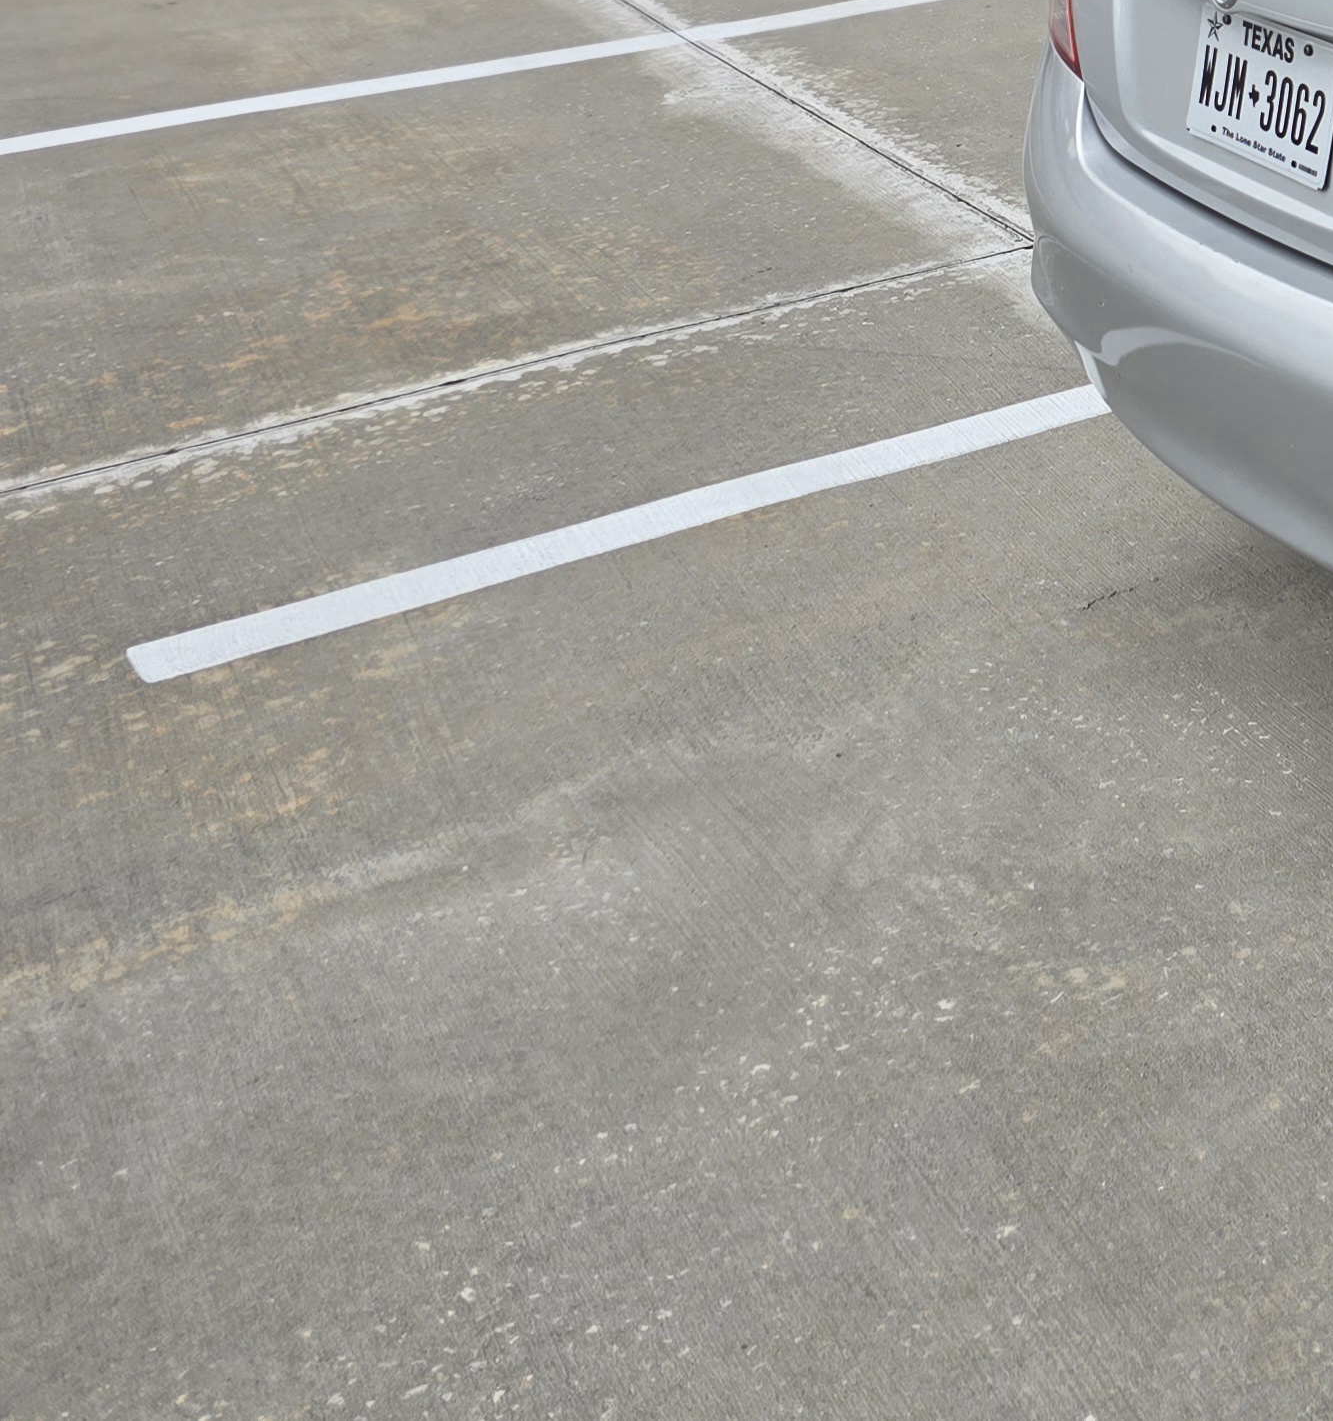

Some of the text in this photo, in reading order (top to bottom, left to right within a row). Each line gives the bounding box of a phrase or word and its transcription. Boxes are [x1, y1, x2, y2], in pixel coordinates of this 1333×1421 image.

[1242, 20, 1295, 64] TEXAS
[1198, 44, 1327, 155] WJM 3062
